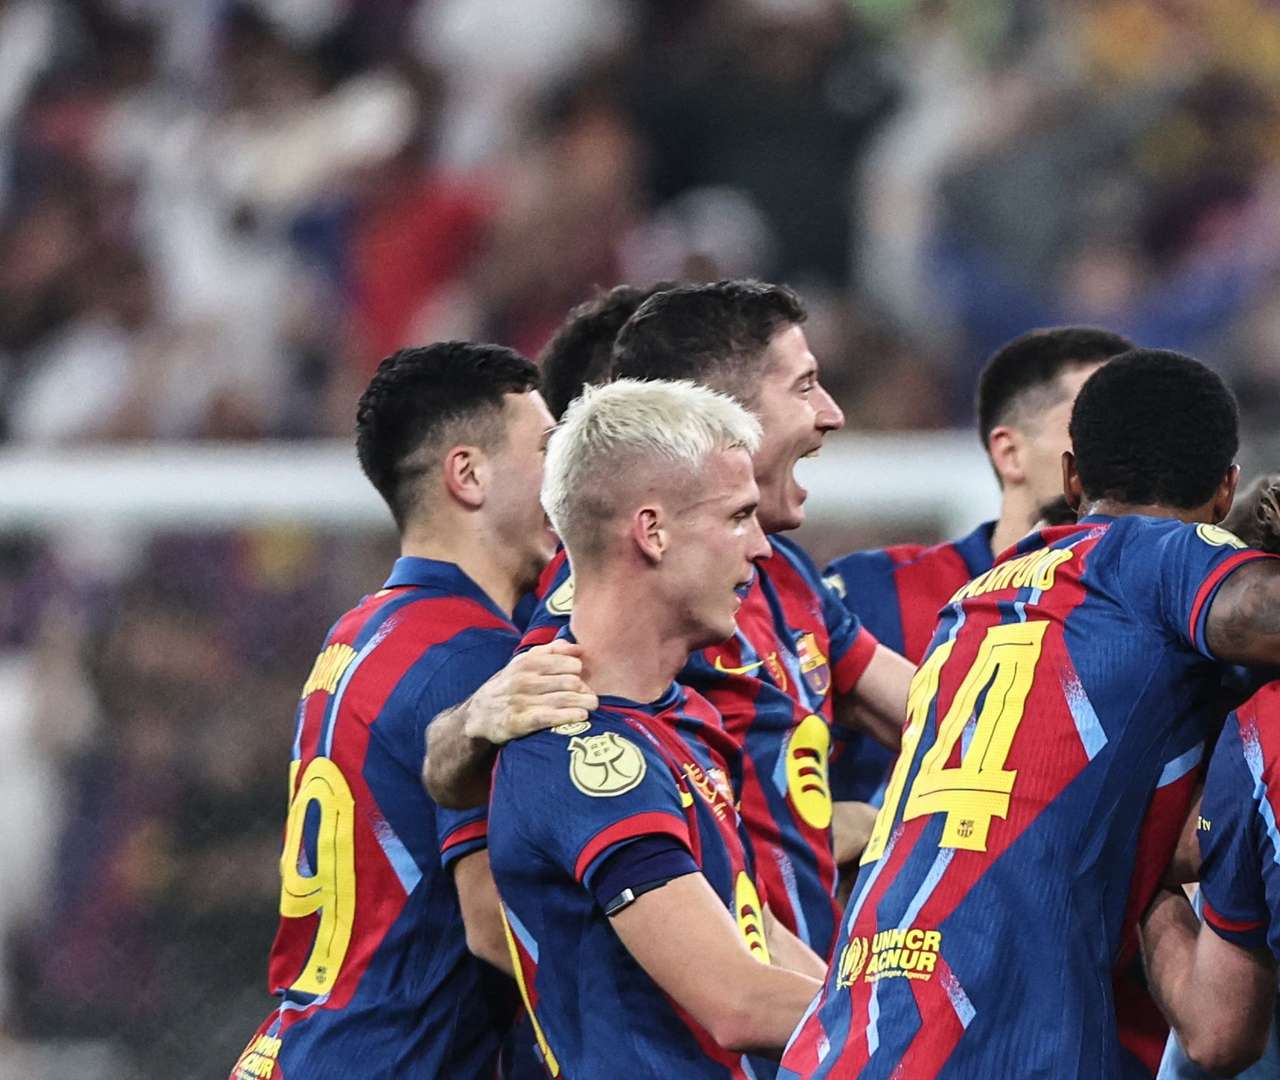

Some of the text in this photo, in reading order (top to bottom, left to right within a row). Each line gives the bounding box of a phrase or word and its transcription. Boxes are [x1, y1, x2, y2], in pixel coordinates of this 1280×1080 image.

[859, 620, 1050, 866] 14
[279, 756, 356, 996] 9
[872, 929, 942, 954] UNHCR
[865, 949, 937, 973] ACNUR
